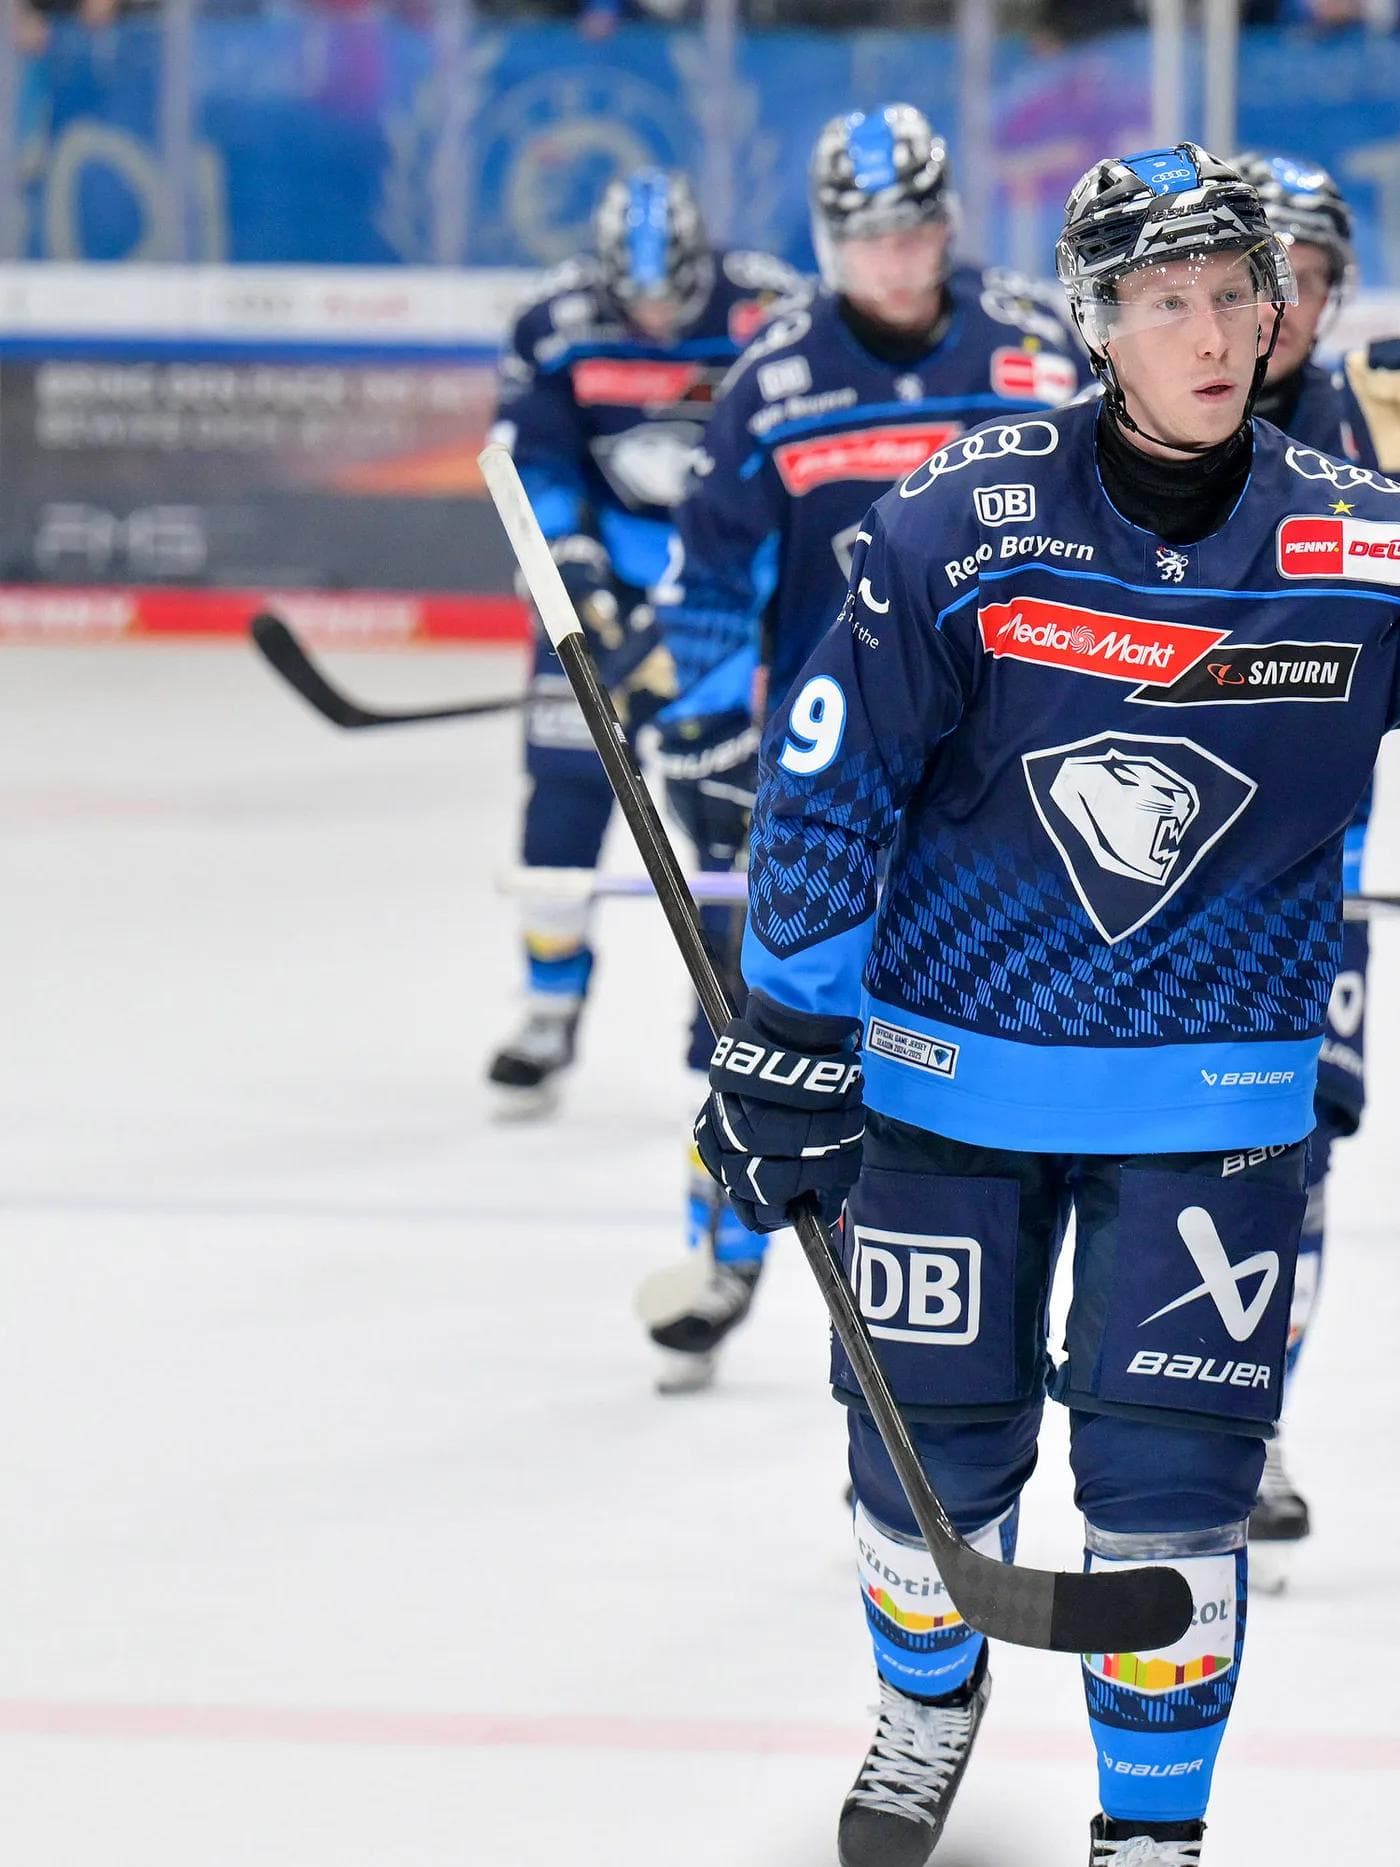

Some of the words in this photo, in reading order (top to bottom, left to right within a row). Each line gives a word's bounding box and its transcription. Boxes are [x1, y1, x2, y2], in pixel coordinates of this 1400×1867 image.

[981, 489, 1028, 521] DB
[999, 535, 1095, 561] Bayern
[858, 626, 880, 649] the
[1247, 660, 1340, 685] SATURN
[776, 674, 847, 777] 9
[875, 1027, 893, 1040] OFFICIAL
[894, 1034, 908, 1046] GAME
[908, 1040, 927, 1051] JERSEY
[1220, 1071, 1295, 1086] BAUER
[859, 1244, 962, 1327] DB
[1126, 1350, 1271, 1389] BAUER
[1115, 1758, 1204, 1777] BAUER
